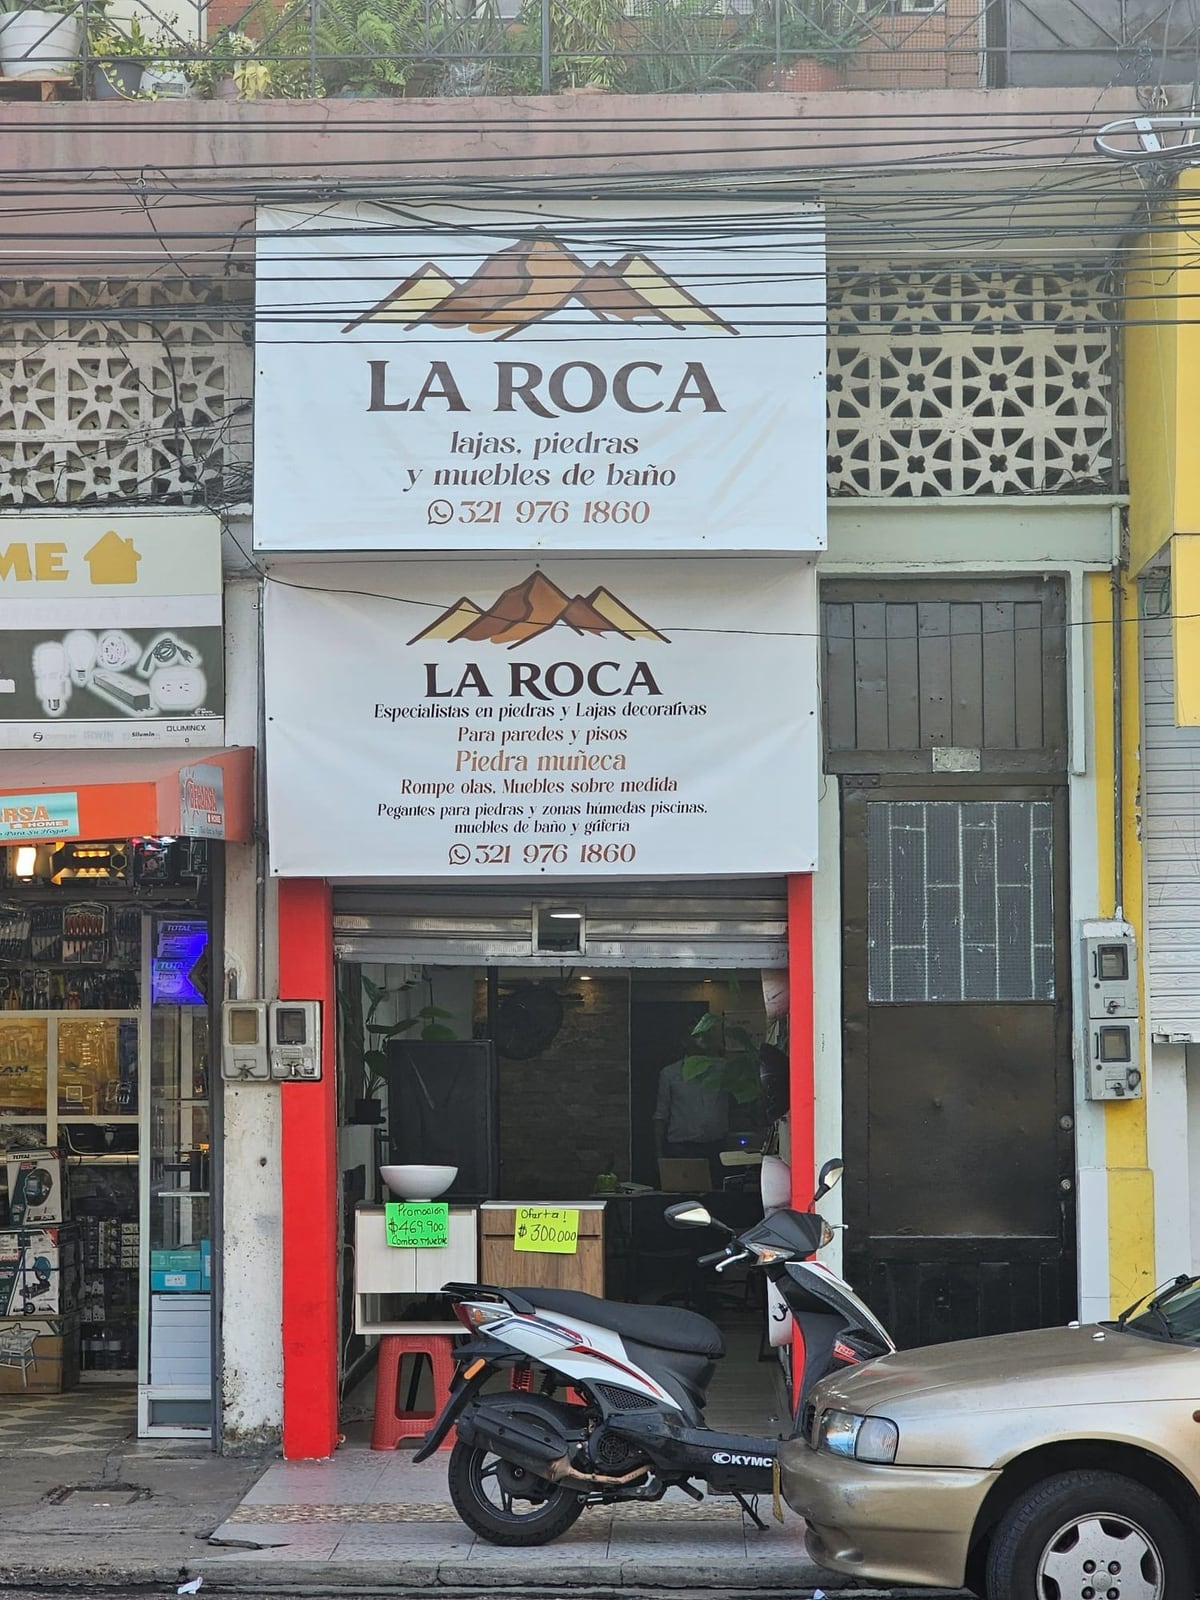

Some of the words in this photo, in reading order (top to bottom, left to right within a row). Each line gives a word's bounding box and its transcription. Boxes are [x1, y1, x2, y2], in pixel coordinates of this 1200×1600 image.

[366, 360, 471, 412] LA
[493, 361, 727, 418] ROCA
[533, 431, 639, 460] piedras
[403, 469, 423, 492] y
[434, 463, 550, 487] muebles
[562, 463, 595, 487] de
[607, 463, 676, 487] baño
[459, 501, 501, 524] 321
[516, 501, 569, 524] 976
[583, 501, 650, 524] 1860
[424, 663, 493, 698] LA
[507, 661, 663, 700] ROCA
[374, 703, 469, 722] Especialistas
[475, 706, 493, 718] en
[499, 703, 555, 722] piedras
[559, 706, 571, 721] y
[575, 702, 616, 721] Lajas
[622, 701, 707, 717] decorativas
[458, 727, 495, 742] Para
[501, 726, 564, 746] paredes
[569, 730, 580, 746] y
[586, 726, 628, 746] pisos
[456, 749, 528, 772] Piedra
[537, 750, 626, 772] muñeca
[401, 778, 455, 799] Rompe
[502, 777, 565, 794] Muebles
[570, 777, 615, 793] sobre
[620, 776, 678, 793] medida
[0, 805, 49, 824] RSA
[378, 803, 435, 820] Pegantes
[439, 806, 470, 820] para
[475, 803, 524, 820] piedras
[528, 806, 538, 819] y
[542, 805, 581, 815] zonas
[585, 801, 646, 815] húmedas
[28, 820, 64, 828] HOME
[454, 820, 508, 834] muebles
[513, 820, 529, 833] de
[533, 820, 566, 833] baño
[570, 823, 579, 836] y
[475, 844, 511, 864] 321
[523, 844, 568, 864] 976
[580, 843, 637, 864] 1860
